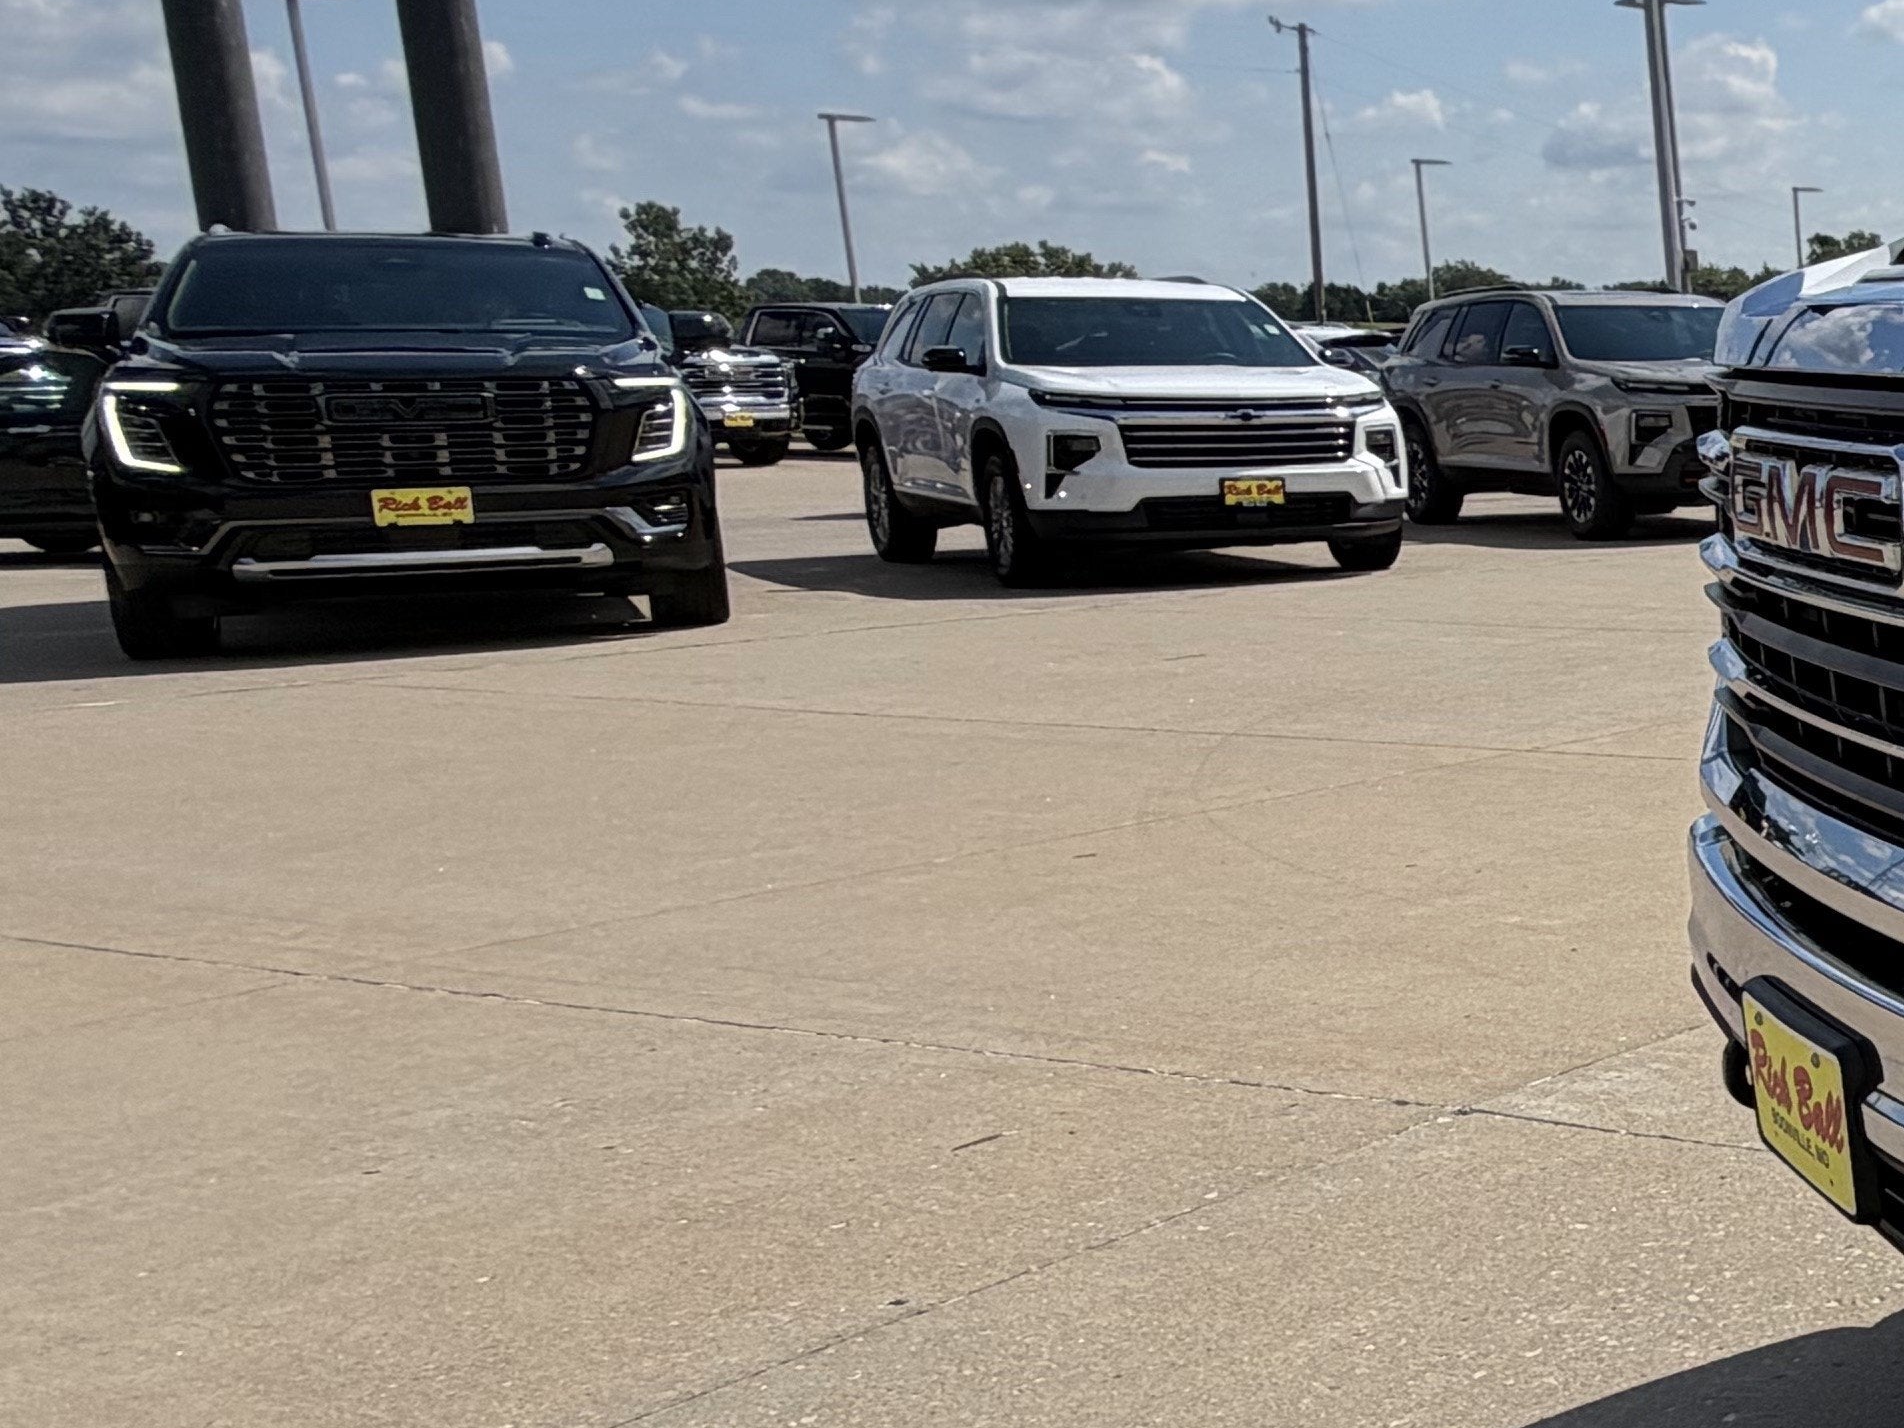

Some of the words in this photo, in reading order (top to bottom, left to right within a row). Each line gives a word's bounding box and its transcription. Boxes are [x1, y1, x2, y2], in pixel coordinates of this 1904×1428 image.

[378, 496, 422, 513] Rick
[426, 495, 469, 511] Ball
[1731, 451, 1902, 571] GMC
[1750, 1028, 1793, 1115] Rick
[1793, 1065, 1845, 1154] Ball
